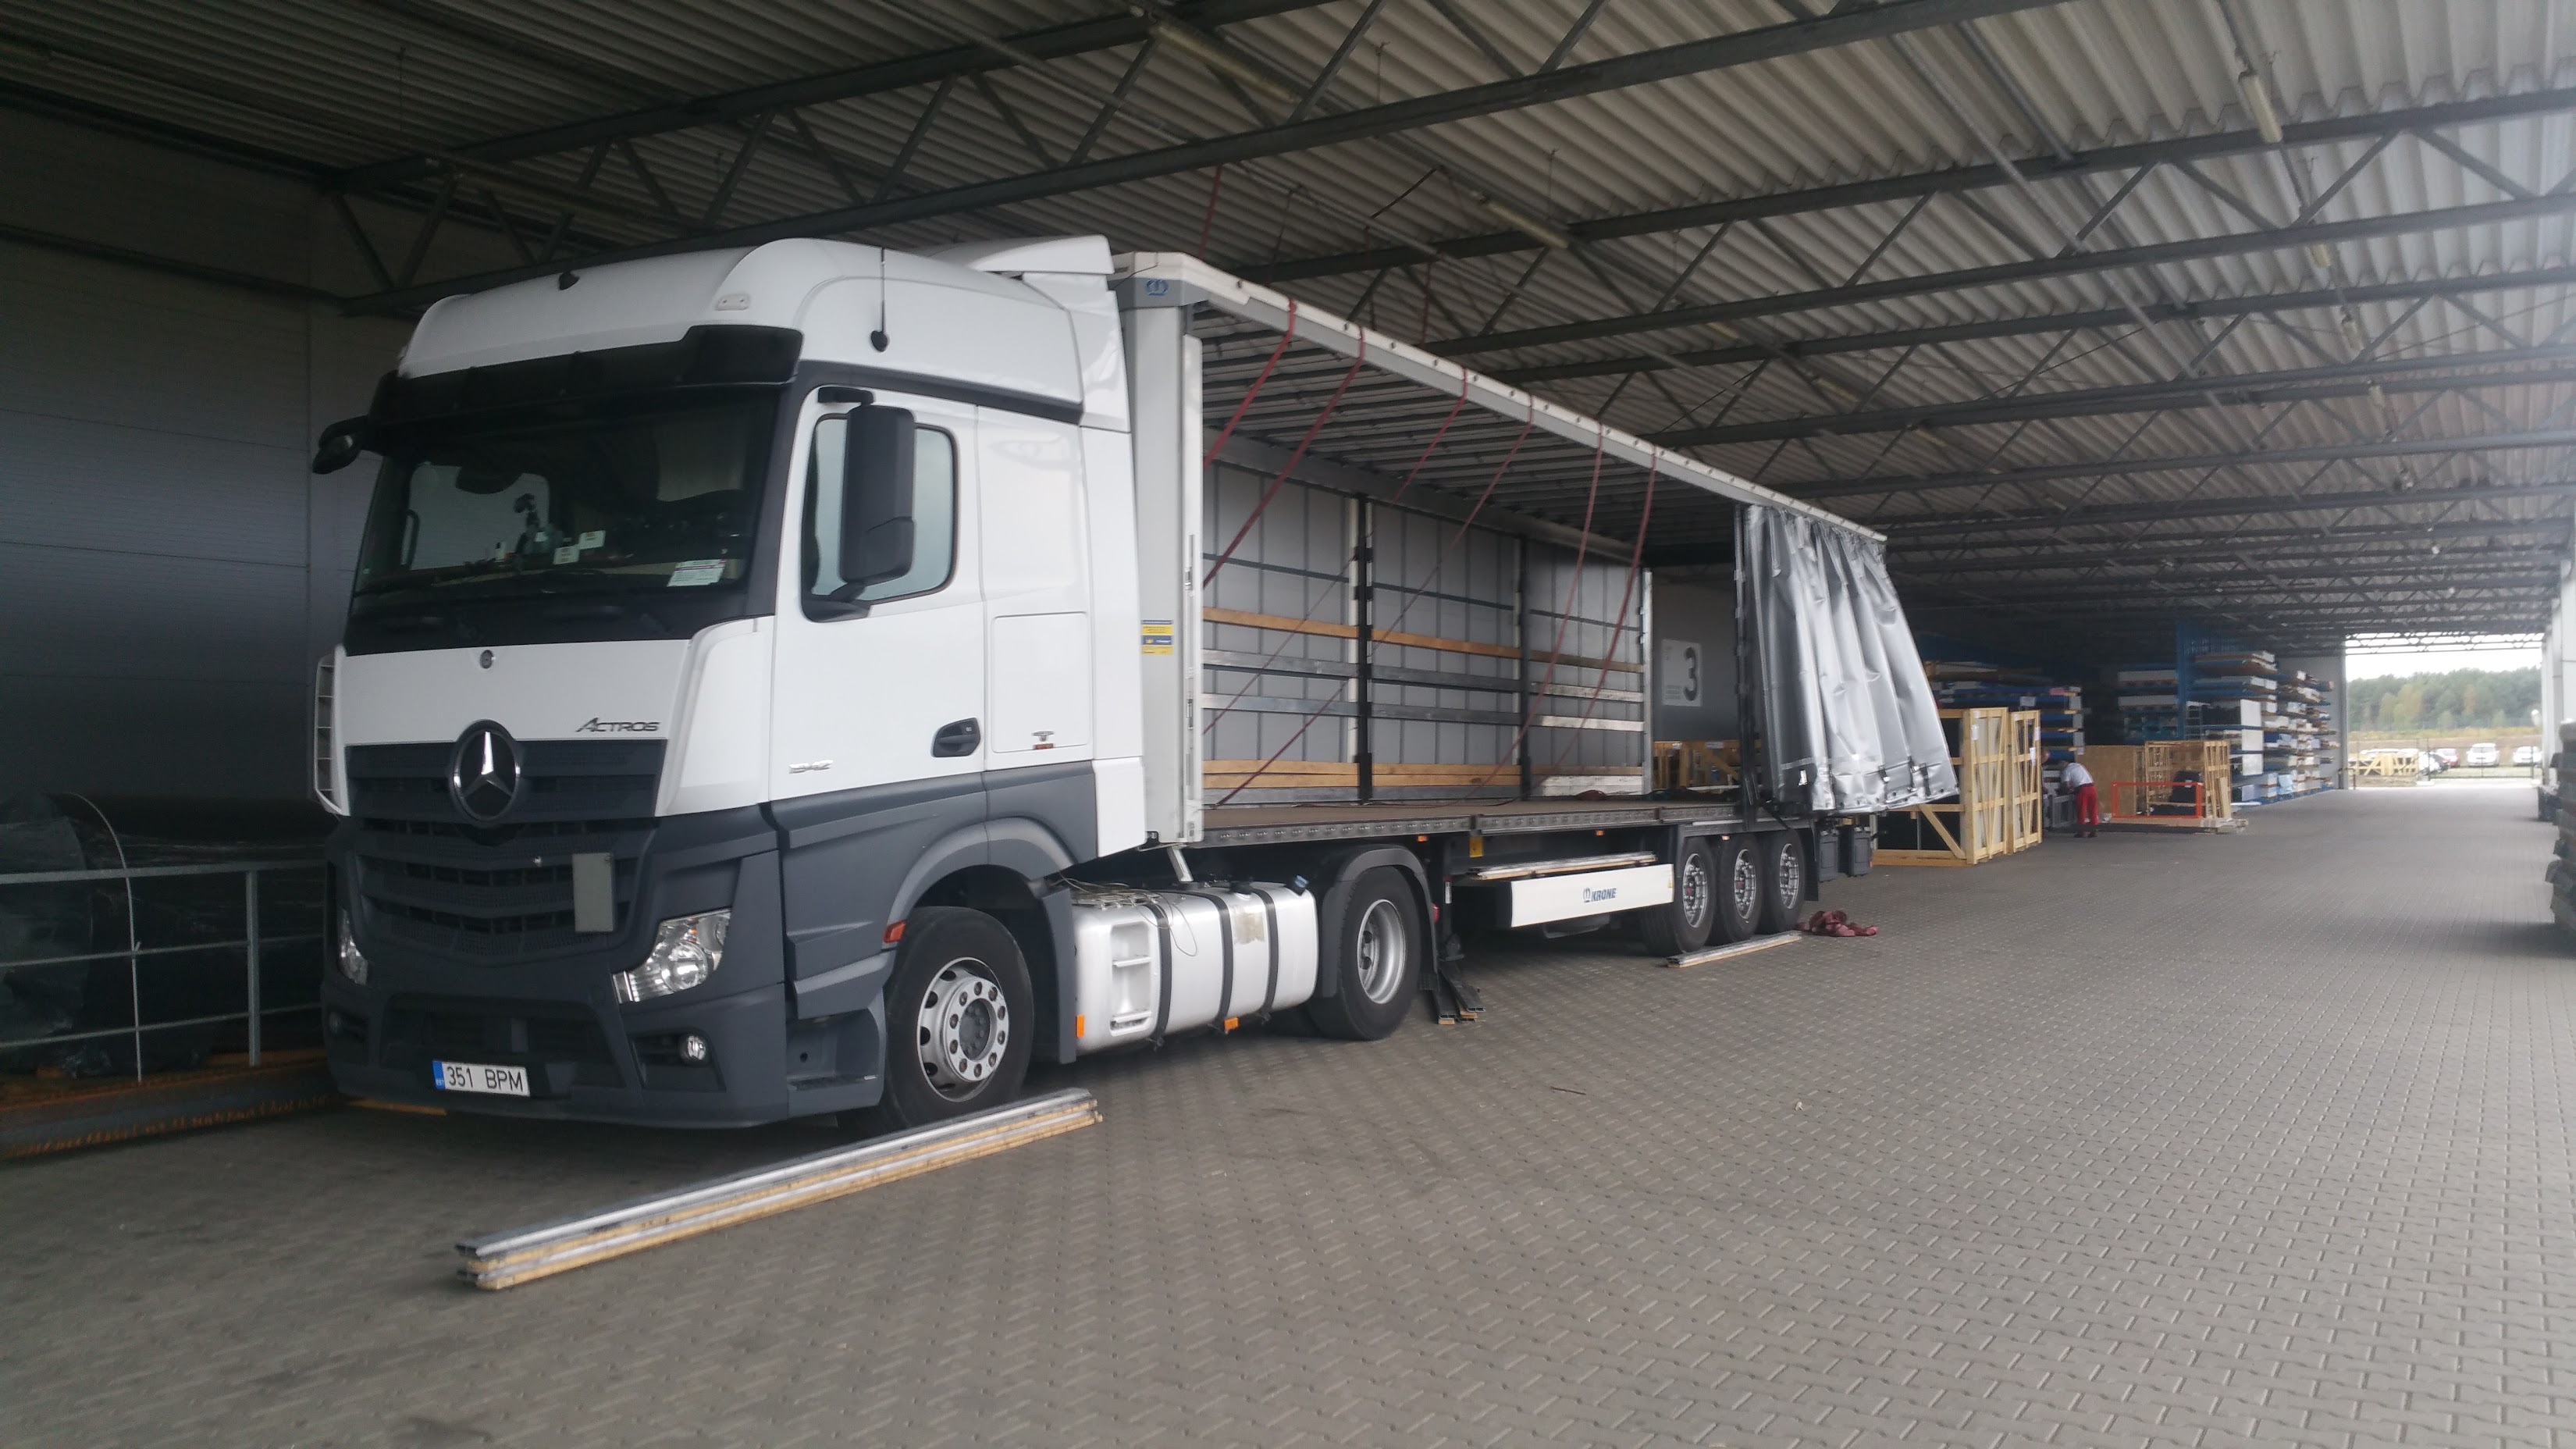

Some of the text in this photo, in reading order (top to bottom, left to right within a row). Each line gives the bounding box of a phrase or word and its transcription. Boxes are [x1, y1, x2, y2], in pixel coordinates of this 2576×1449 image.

[1683, 646, 1698, 702] 3
[1591, 888, 1617, 902] KRONE
[447, 1066, 523, 1092] 351 BPM
